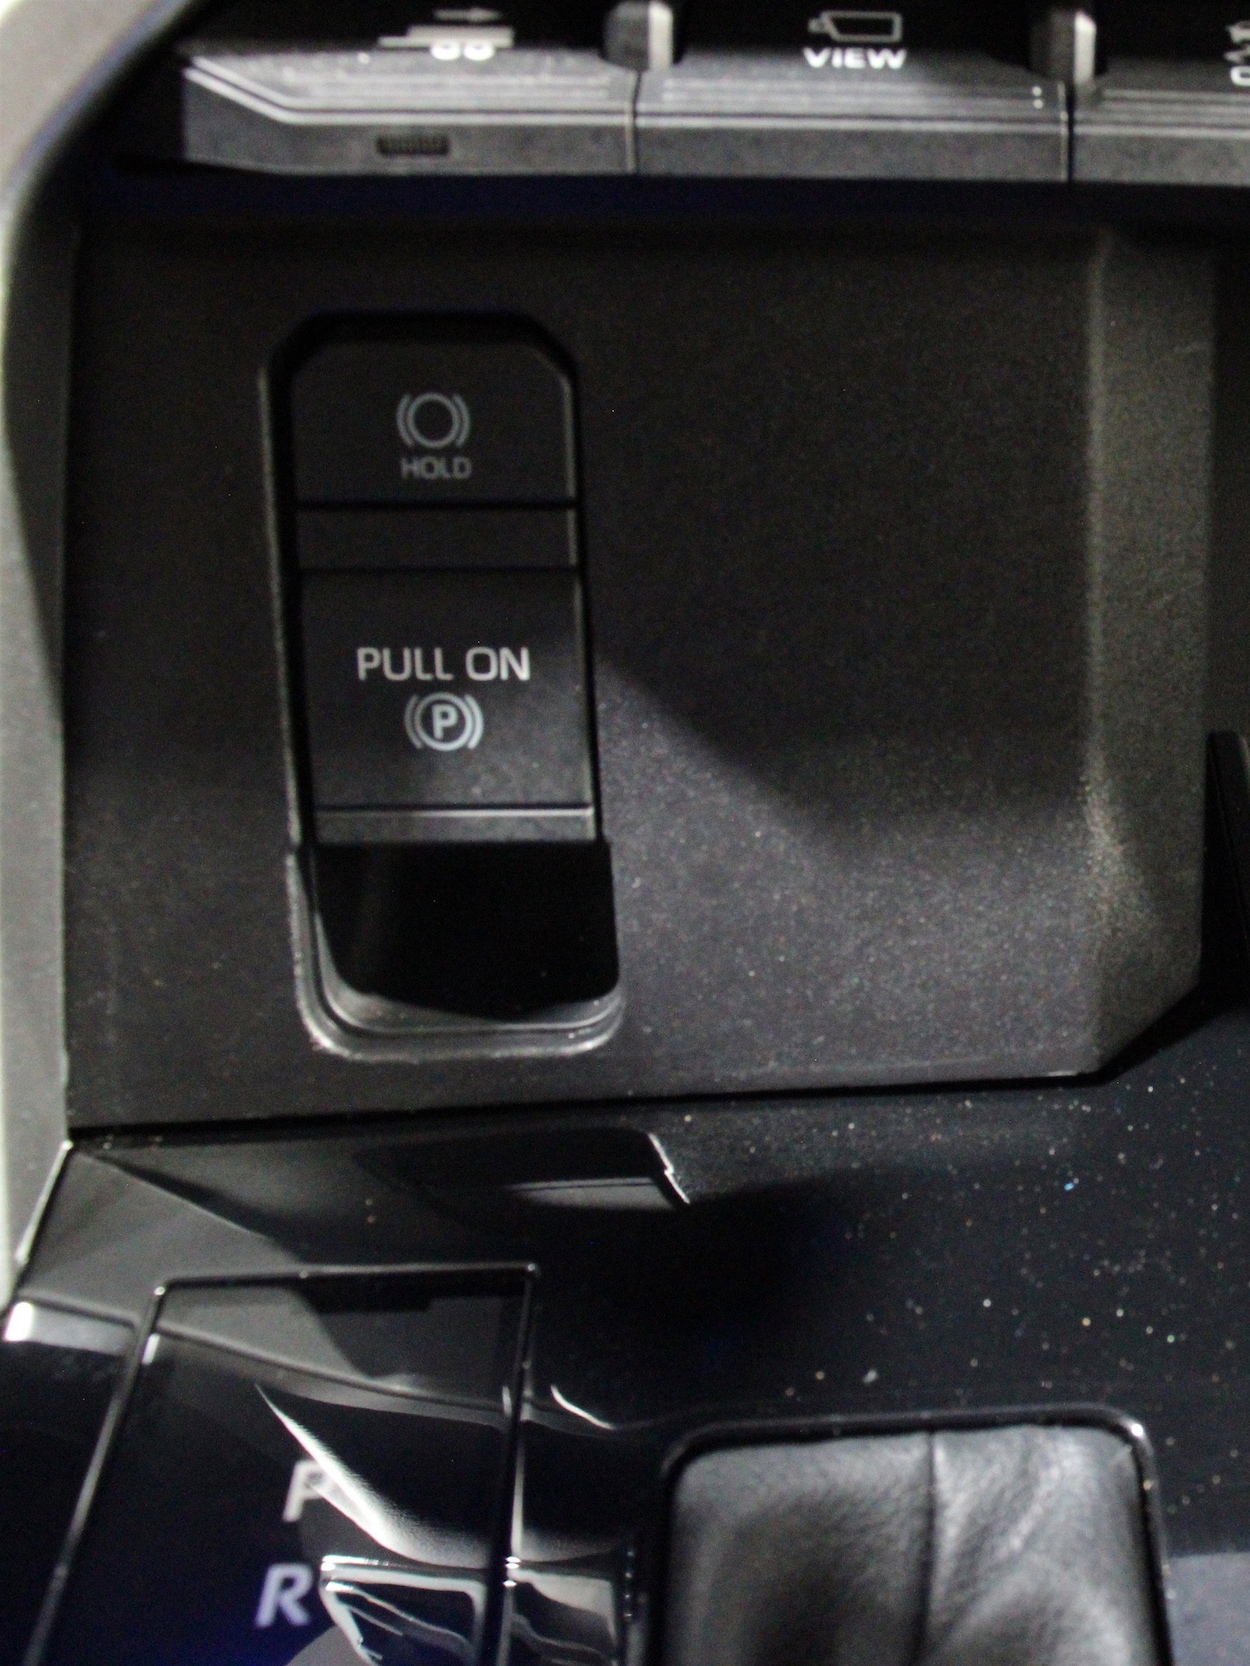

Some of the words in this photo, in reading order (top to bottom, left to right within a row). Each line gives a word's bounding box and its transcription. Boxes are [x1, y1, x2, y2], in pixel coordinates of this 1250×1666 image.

[803, 46, 907, 69] VIEW
[401, 456, 471, 479] HOLD
[357, 647, 454, 681] PULL
[465, 646, 530, 681] ON
[432, 703, 458, 739] P
[255, 1563, 313, 1628] R
